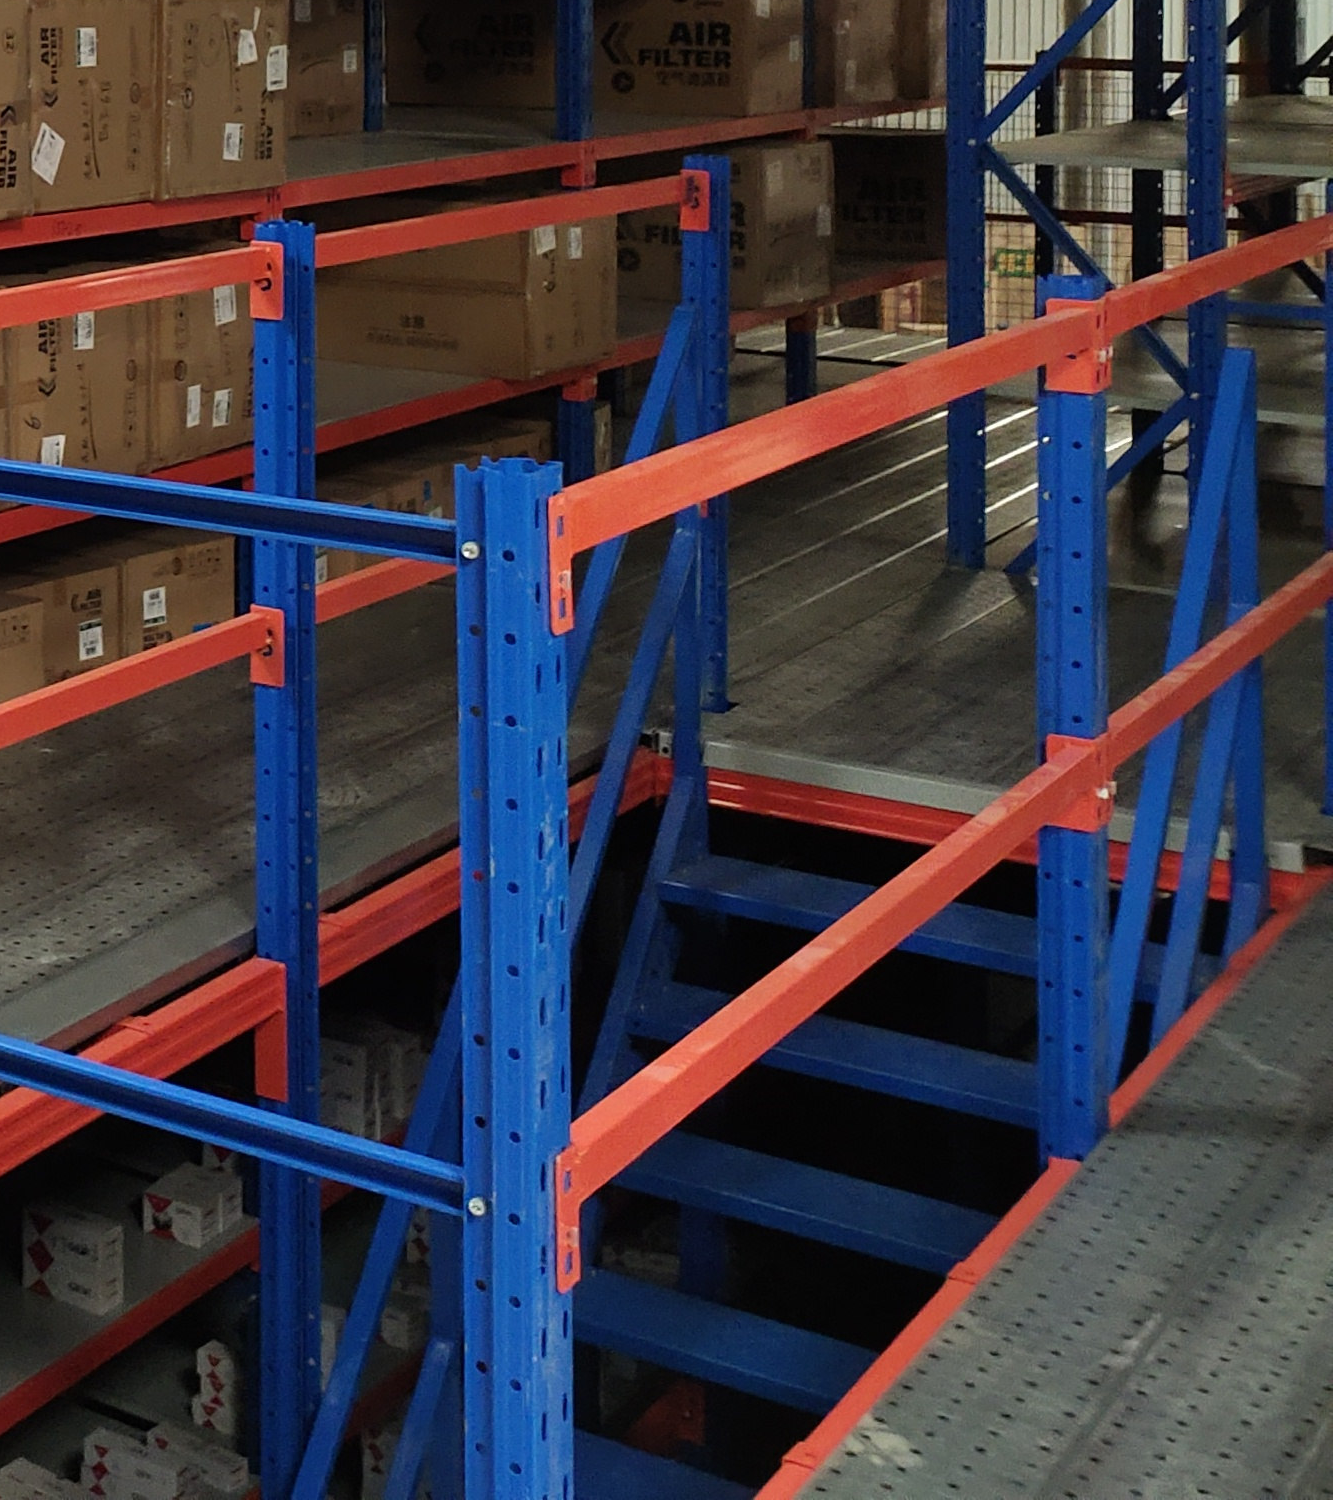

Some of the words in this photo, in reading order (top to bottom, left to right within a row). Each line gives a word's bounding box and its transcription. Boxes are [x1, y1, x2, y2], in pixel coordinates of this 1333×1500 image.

[40, 27, 50, 66] AIR
[669, 22, 732, 47] AIR
[638, 49, 732, 68] FILTER
[265, 125, 274, 161] AIR
[6, 148, 17, 189] AIR
